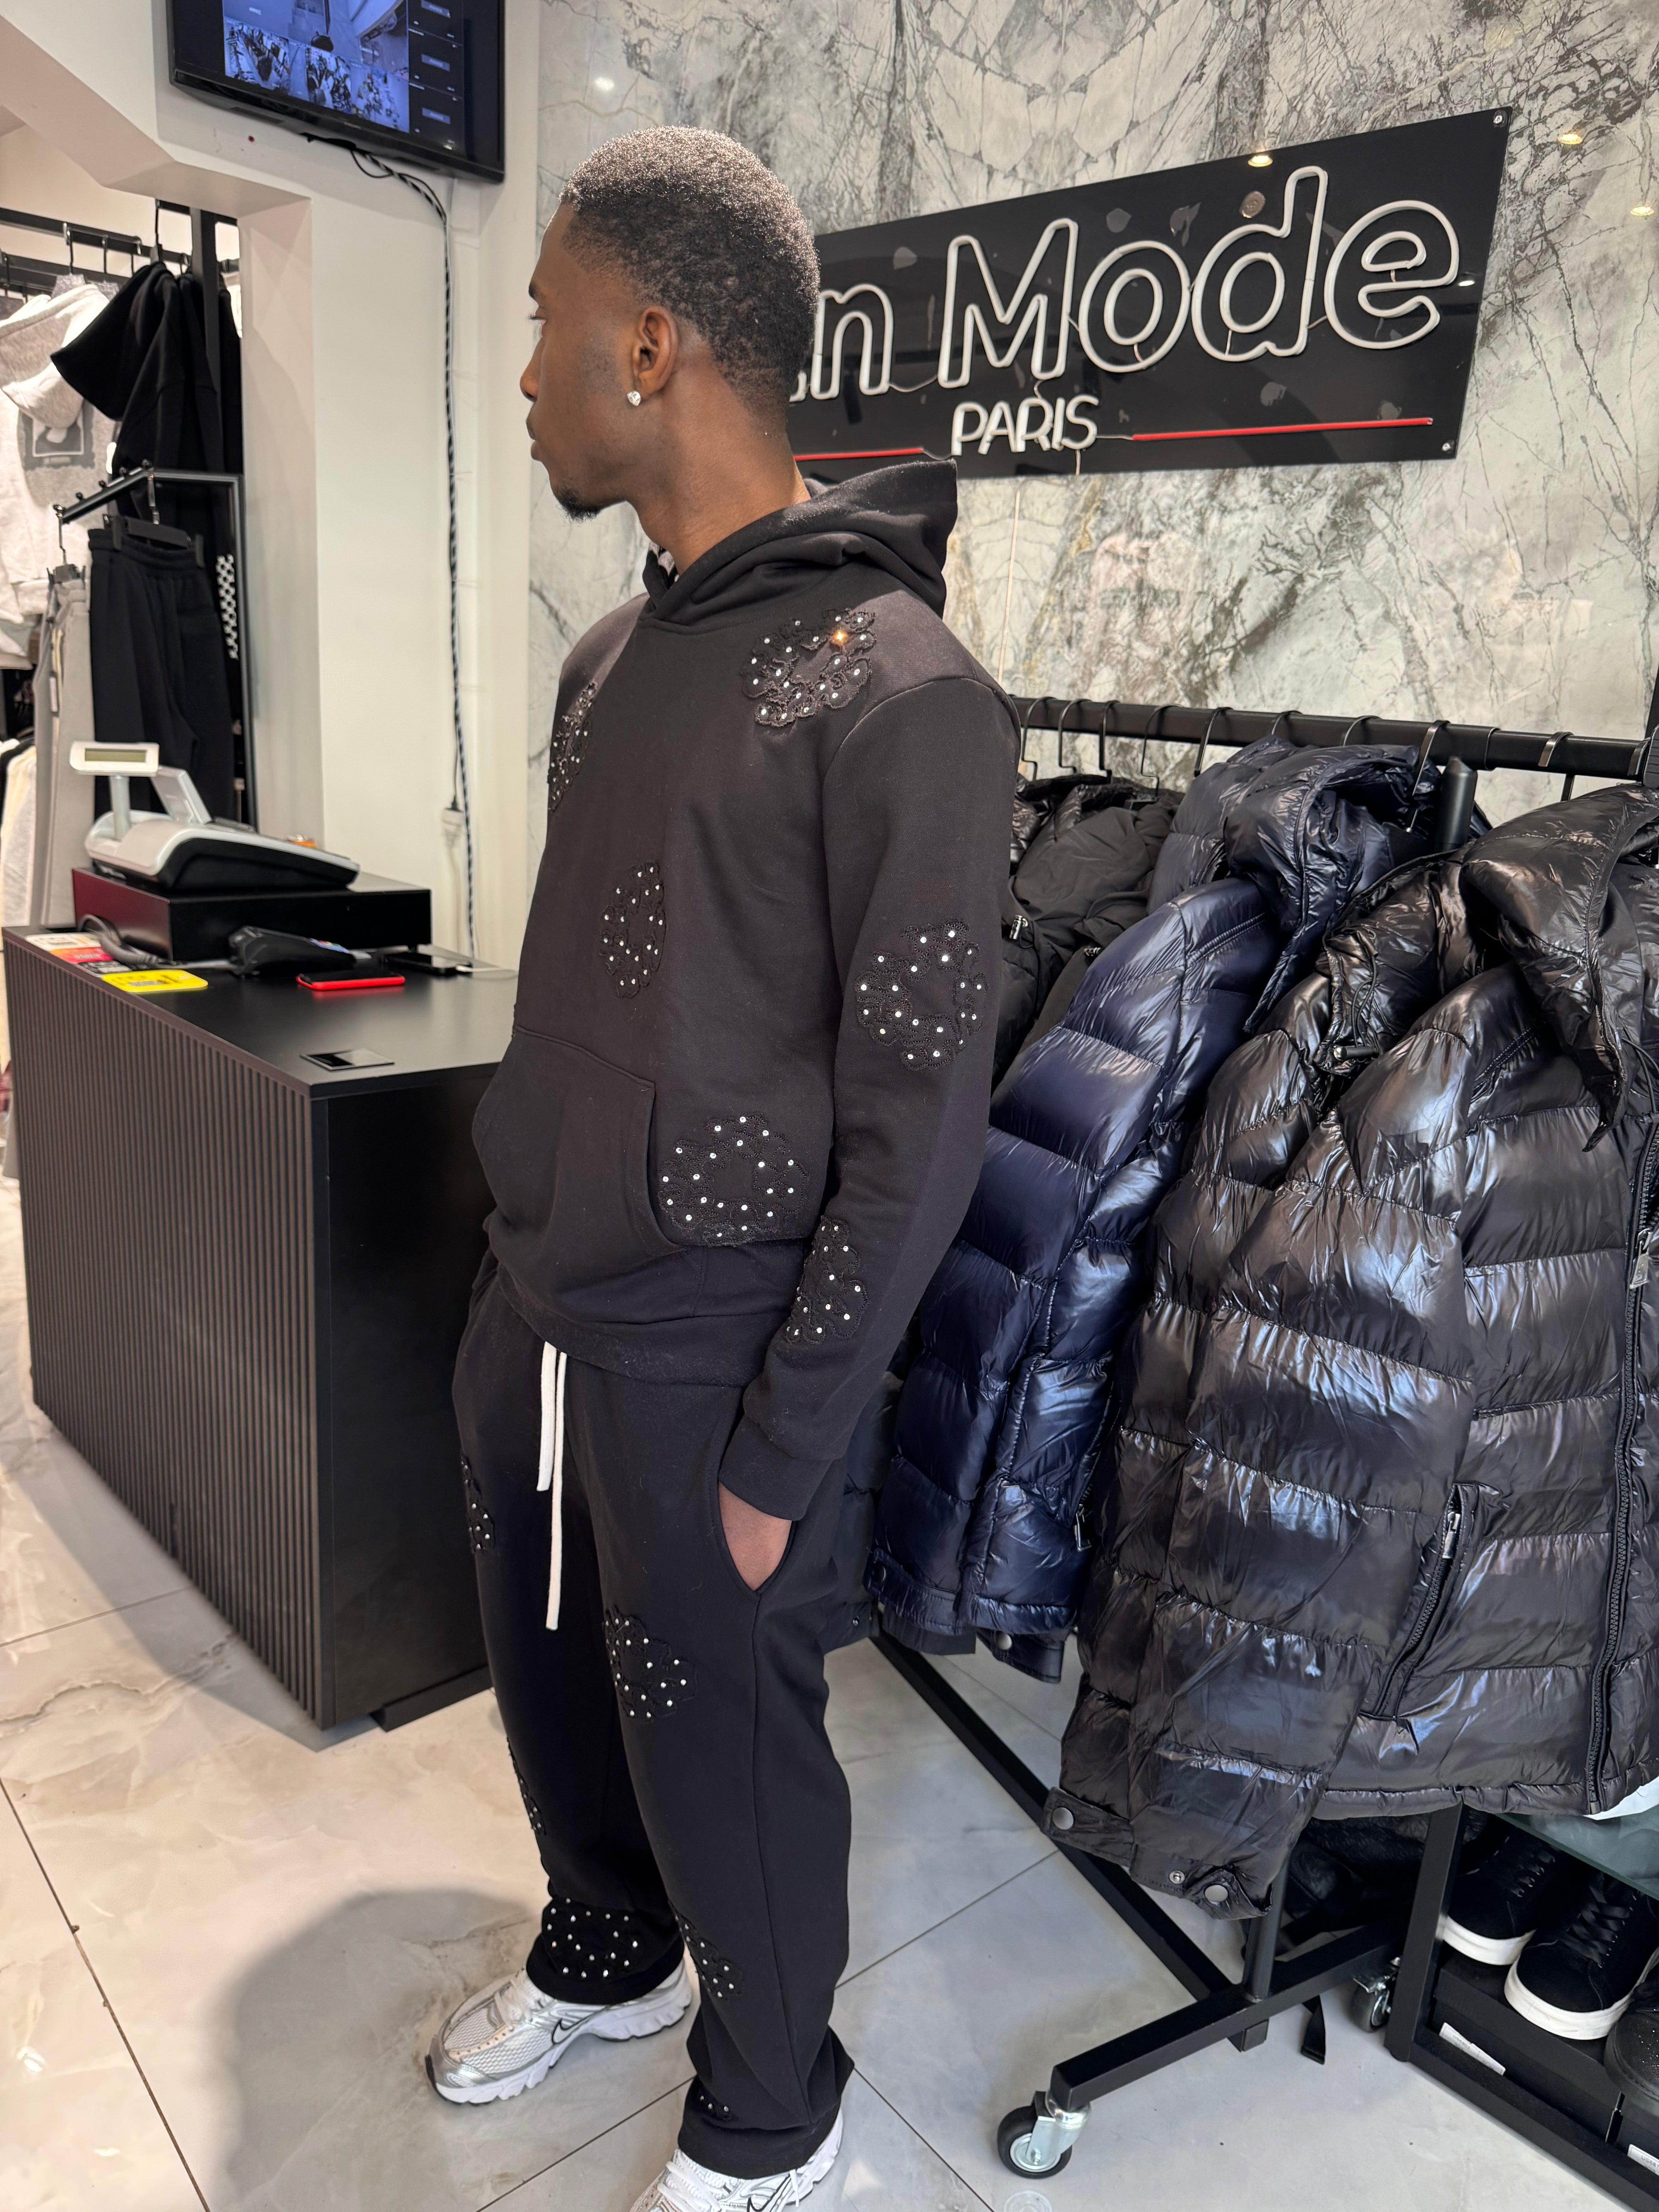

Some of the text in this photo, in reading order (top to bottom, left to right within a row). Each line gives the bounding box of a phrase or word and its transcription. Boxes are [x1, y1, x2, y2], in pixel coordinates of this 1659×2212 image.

[789, 166, 1459, 402] n Mode
[951, 394, 1099, 456] PARIS
